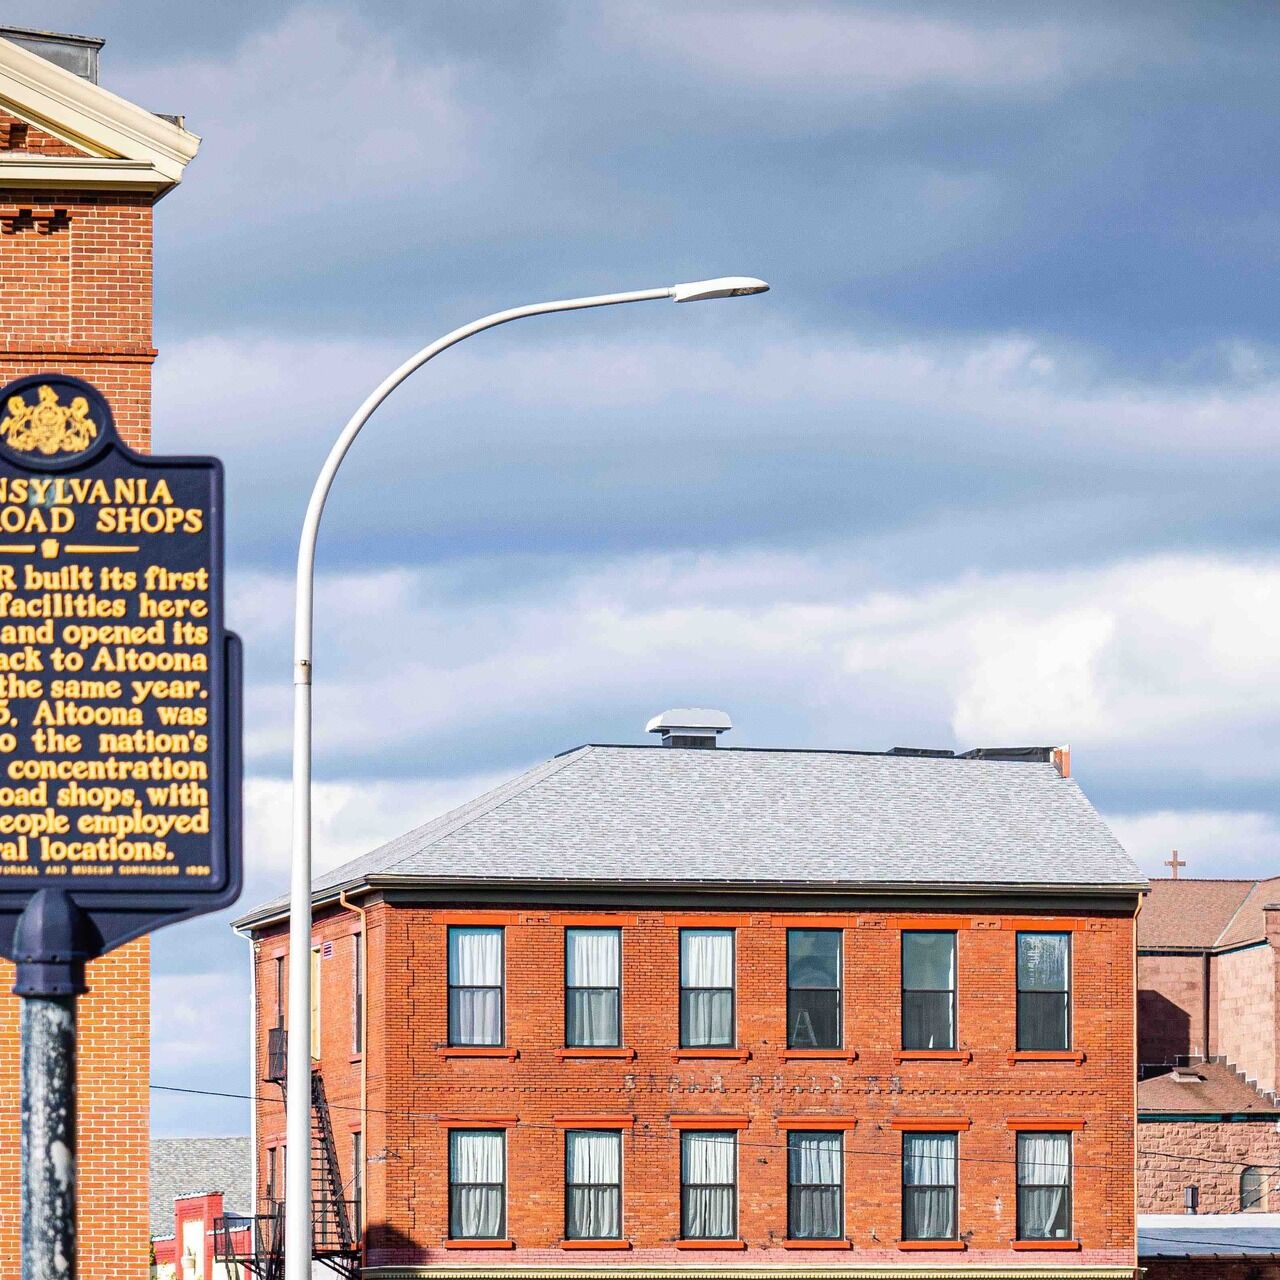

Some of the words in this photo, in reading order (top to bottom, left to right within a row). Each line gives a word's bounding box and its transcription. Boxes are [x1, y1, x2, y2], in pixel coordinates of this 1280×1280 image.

[97, 507, 202, 533] SHOPS
[25, 566, 93, 590] built
[101, 568, 136, 590] its
[145, 566, 208, 590] first
[140, 593, 208, 617] here
[0, 619, 54, 644] and
[63, 620, 165, 647] opened
[174, 622, 208, 644] its
[52, 648, 83, 671] to
[93, 647, 207, 672] Altoona
[52, 681, 121, 698] same
[133, 680, 207, 702] year.
[33, 700, 143, 726] Altoona
[158, 707, 207, 725] was
[32, 728, 81, 752] the
[99, 731, 207, 753] nation's
[9, 758, 207, 780] concentration
[58, 782, 142, 811] shops,
[147, 781, 208, 806] with
[78, 807, 209, 838] employed
[41, 835, 174, 861] locations.
[45, 865, 67, 876] AND
